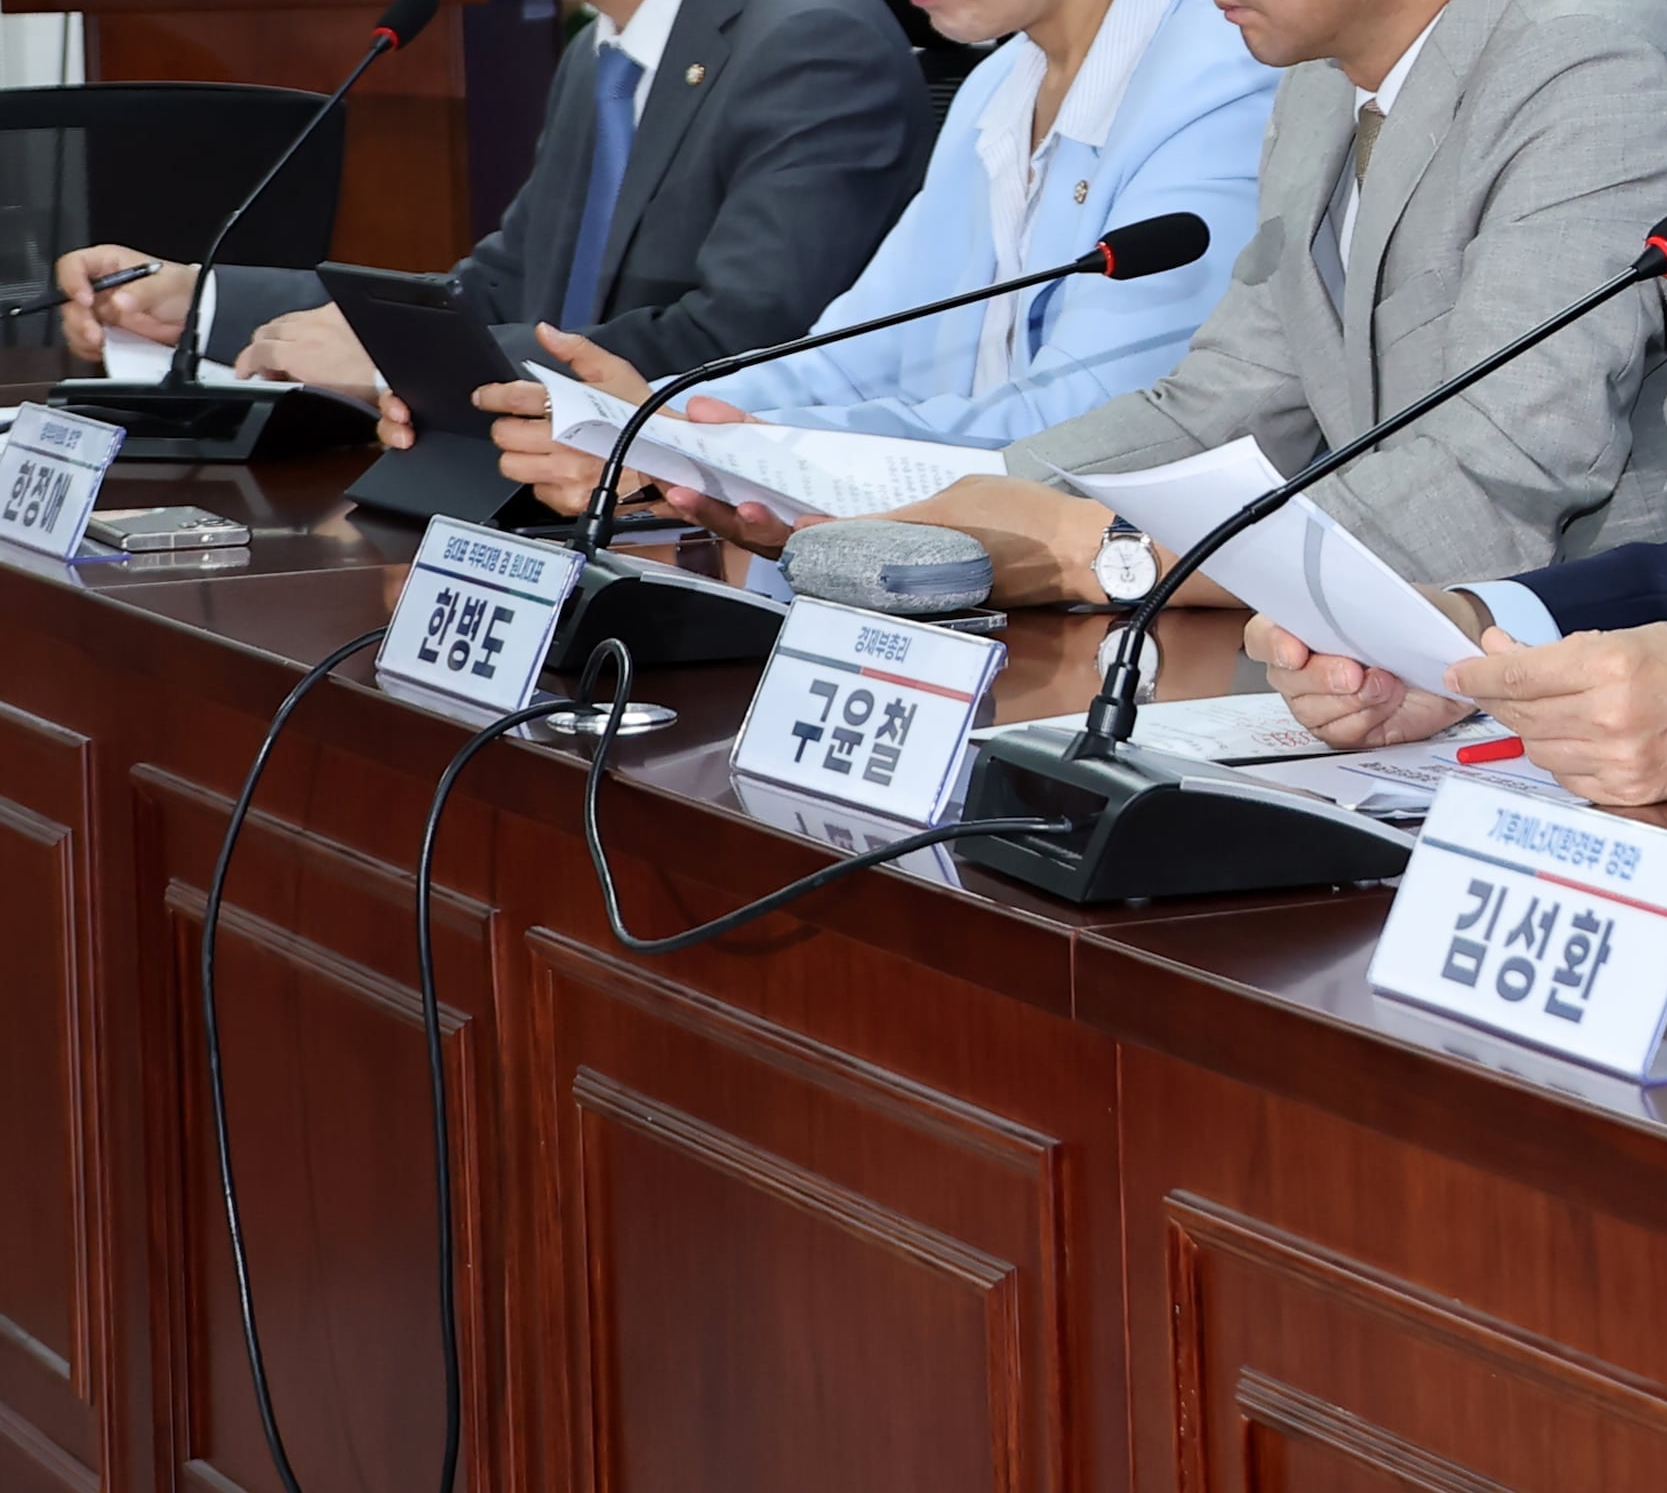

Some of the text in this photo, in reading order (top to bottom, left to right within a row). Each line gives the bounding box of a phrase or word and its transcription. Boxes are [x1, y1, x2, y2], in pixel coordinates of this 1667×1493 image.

[3, 460, 73, 534] 한정애
[418, 587, 515, 680] 한병도
[854, 625, 913, 664] 경제부총리
[791, 678, 918, 787] 구윤철
[1604, 841, 1643, 882] 장관
[1440, 878, 1615, 1024] 김성환
